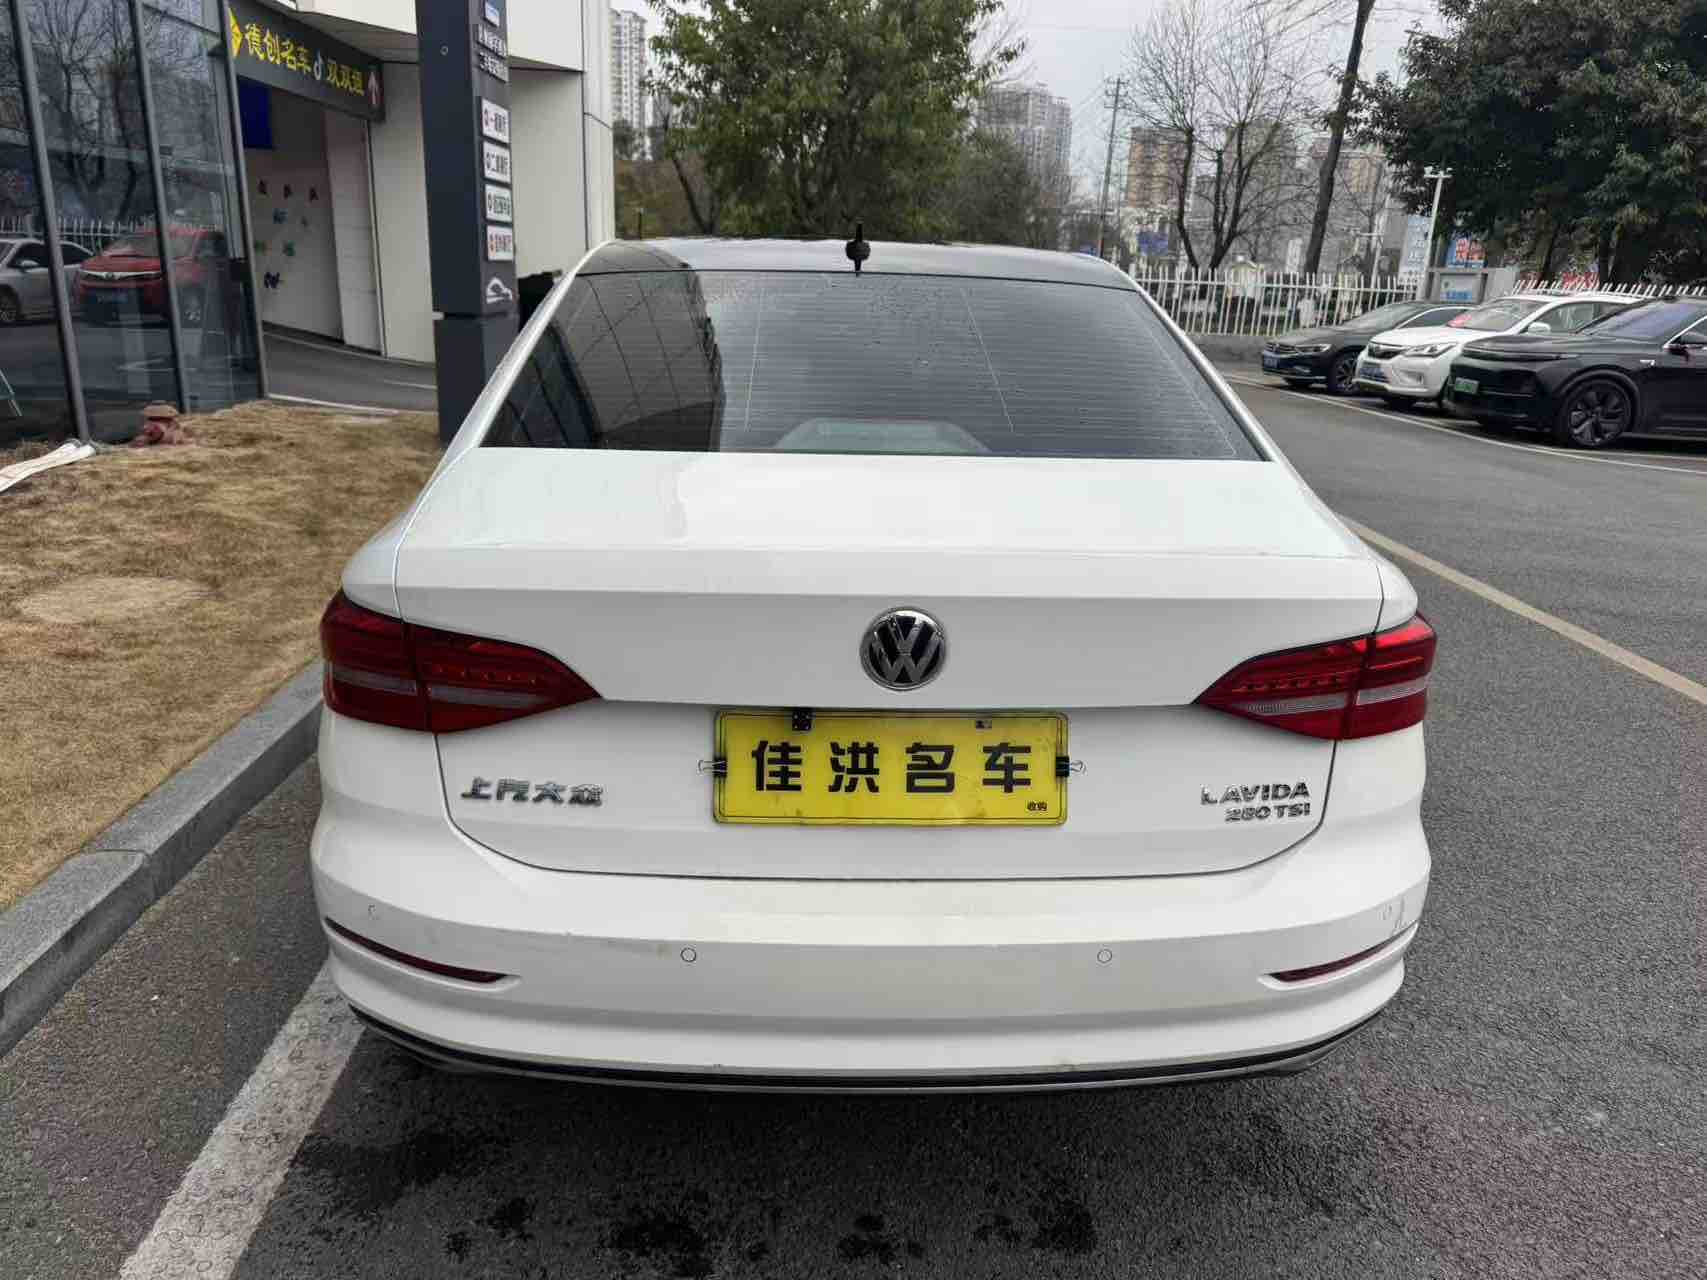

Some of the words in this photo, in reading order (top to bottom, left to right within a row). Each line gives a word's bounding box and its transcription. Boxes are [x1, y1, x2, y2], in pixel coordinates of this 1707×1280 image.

[751, 740, 1032, 794] 佳洪名车
[1201, 782, 1310, 805] LAVIDA
